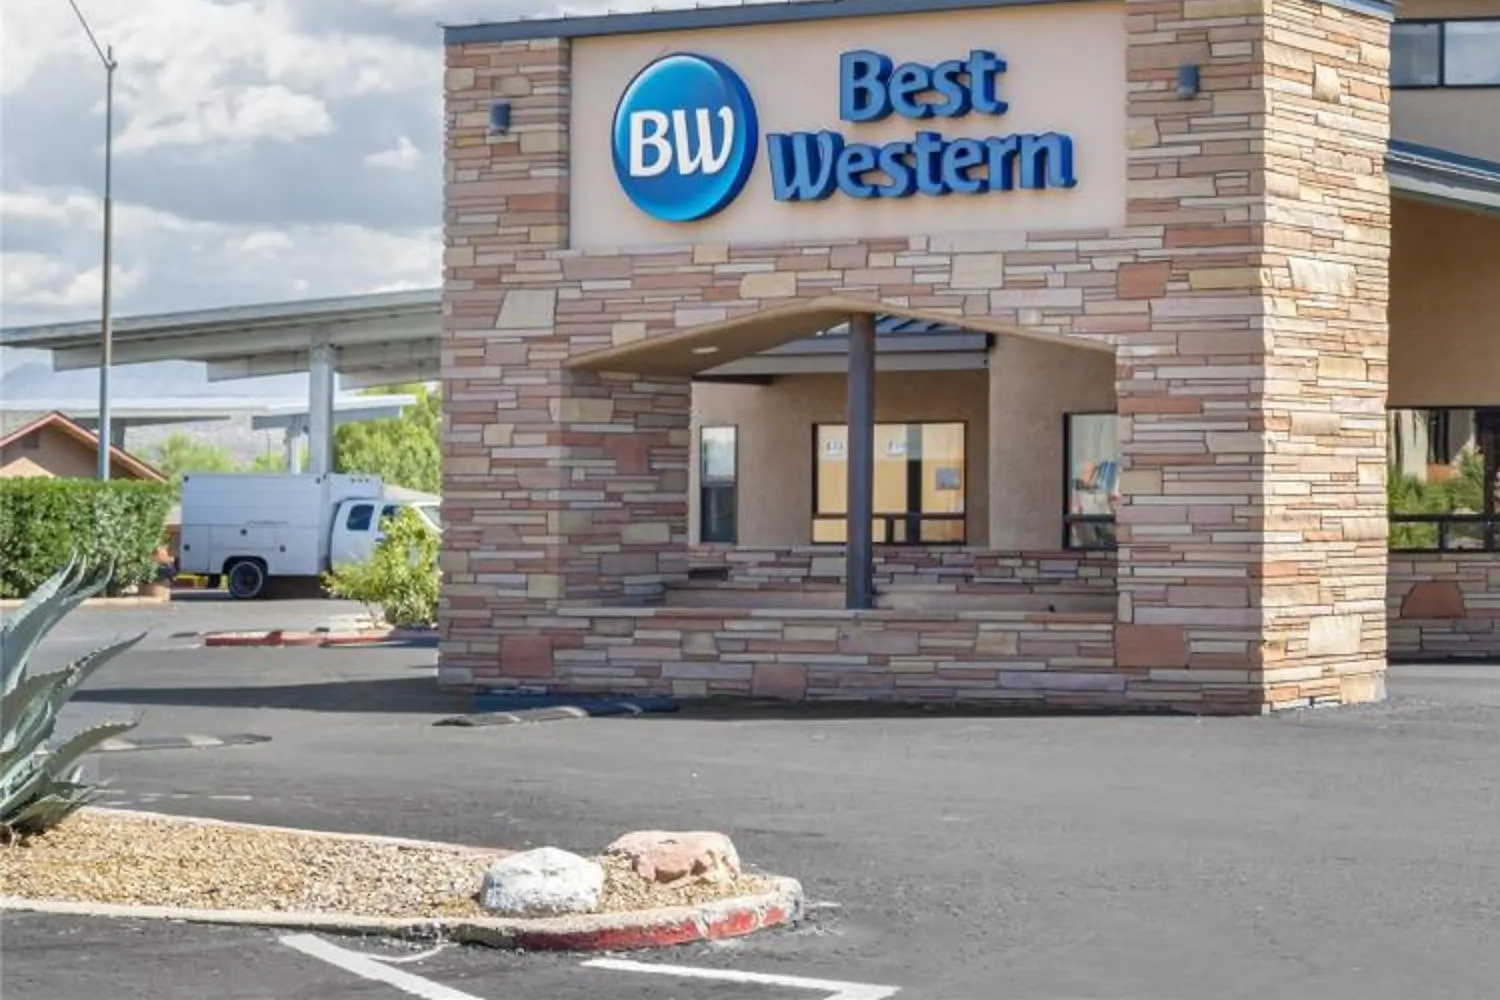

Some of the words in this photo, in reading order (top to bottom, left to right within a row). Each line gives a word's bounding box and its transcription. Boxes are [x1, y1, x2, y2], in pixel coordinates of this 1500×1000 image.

[839, 49, 1008, 123] Best
[629, 105, 735, 177] BW
[766, 130, 1077, 201] Western
